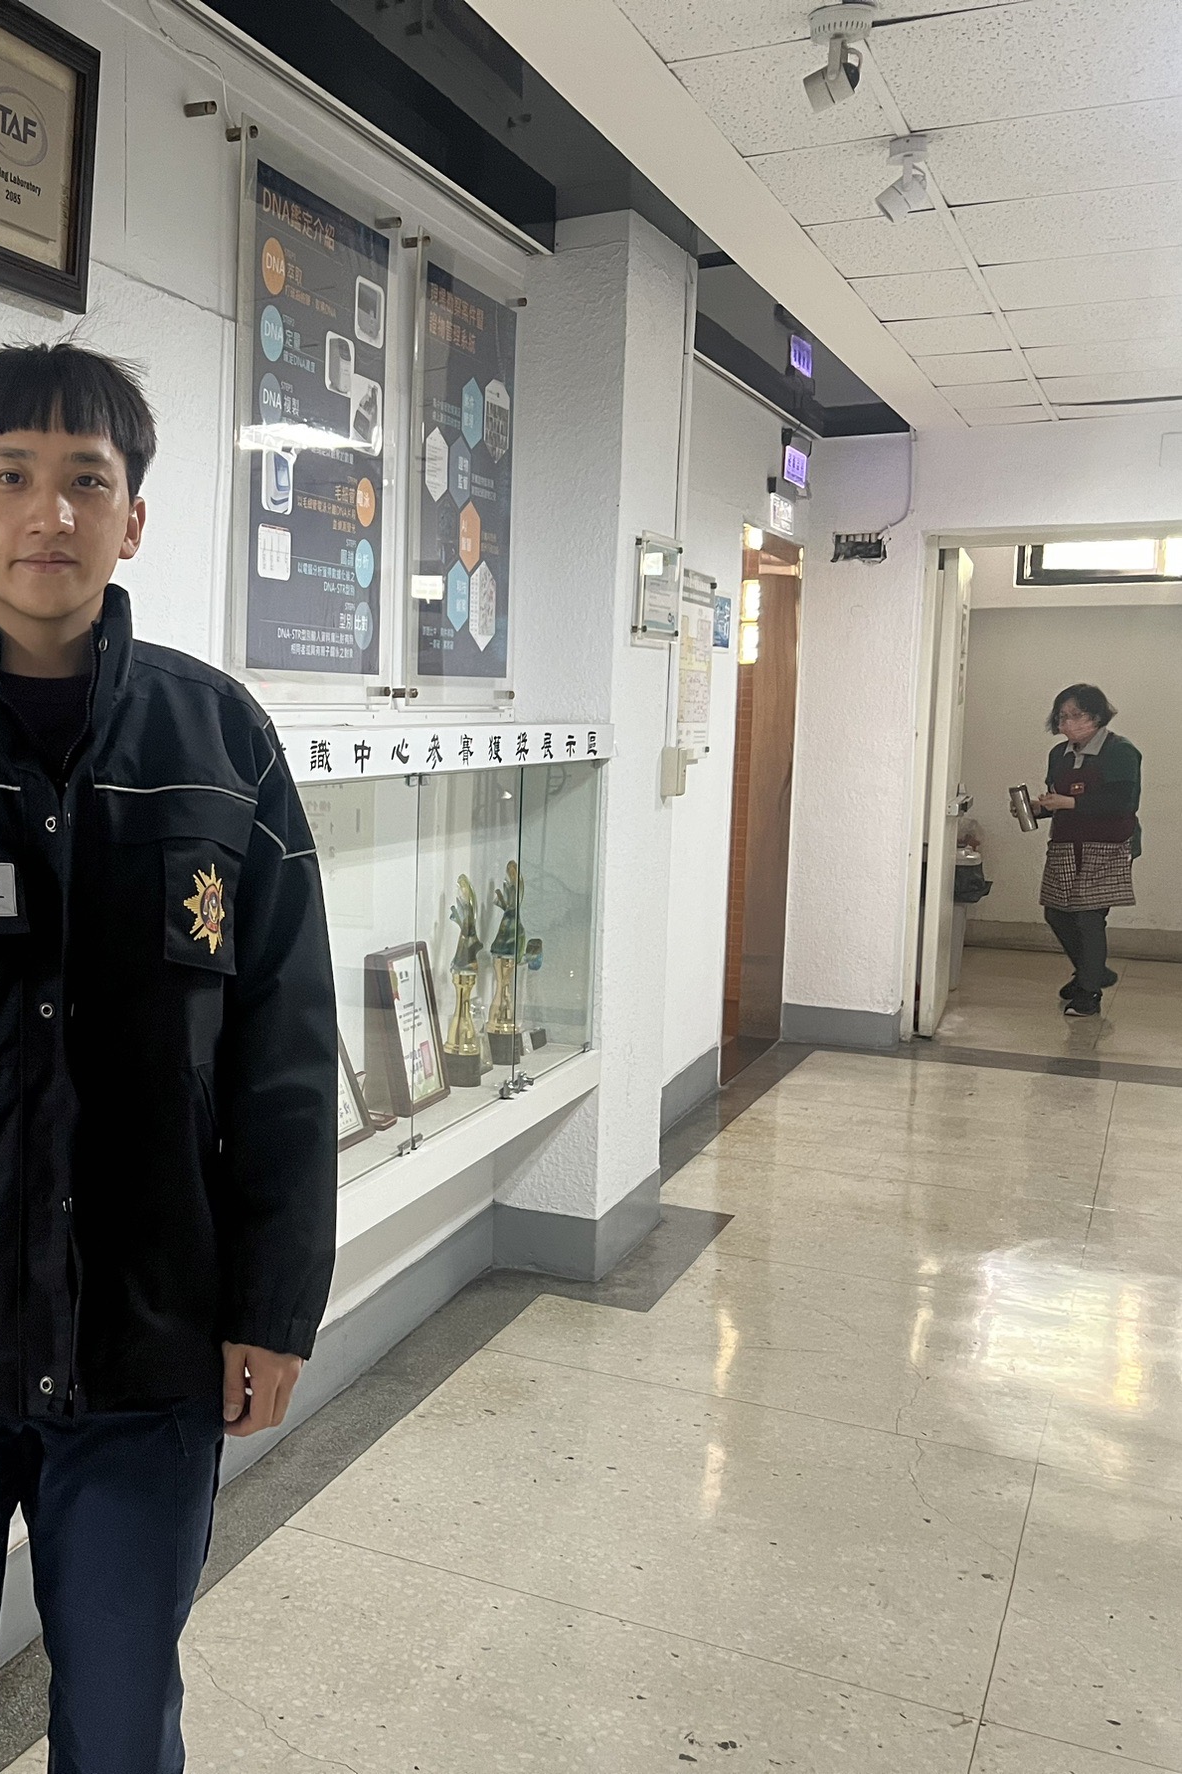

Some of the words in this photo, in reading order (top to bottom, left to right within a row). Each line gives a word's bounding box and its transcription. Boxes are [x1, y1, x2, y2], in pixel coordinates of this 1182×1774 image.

[10, 172, 41, 197] Laboratory
[266, 252, 285, 277] DNA
[264, 320, 284, 342] DNA
[262, 388, 282, 410] DNA
[280, 731, 598, 774] 識中心參賽獲獎展示區
